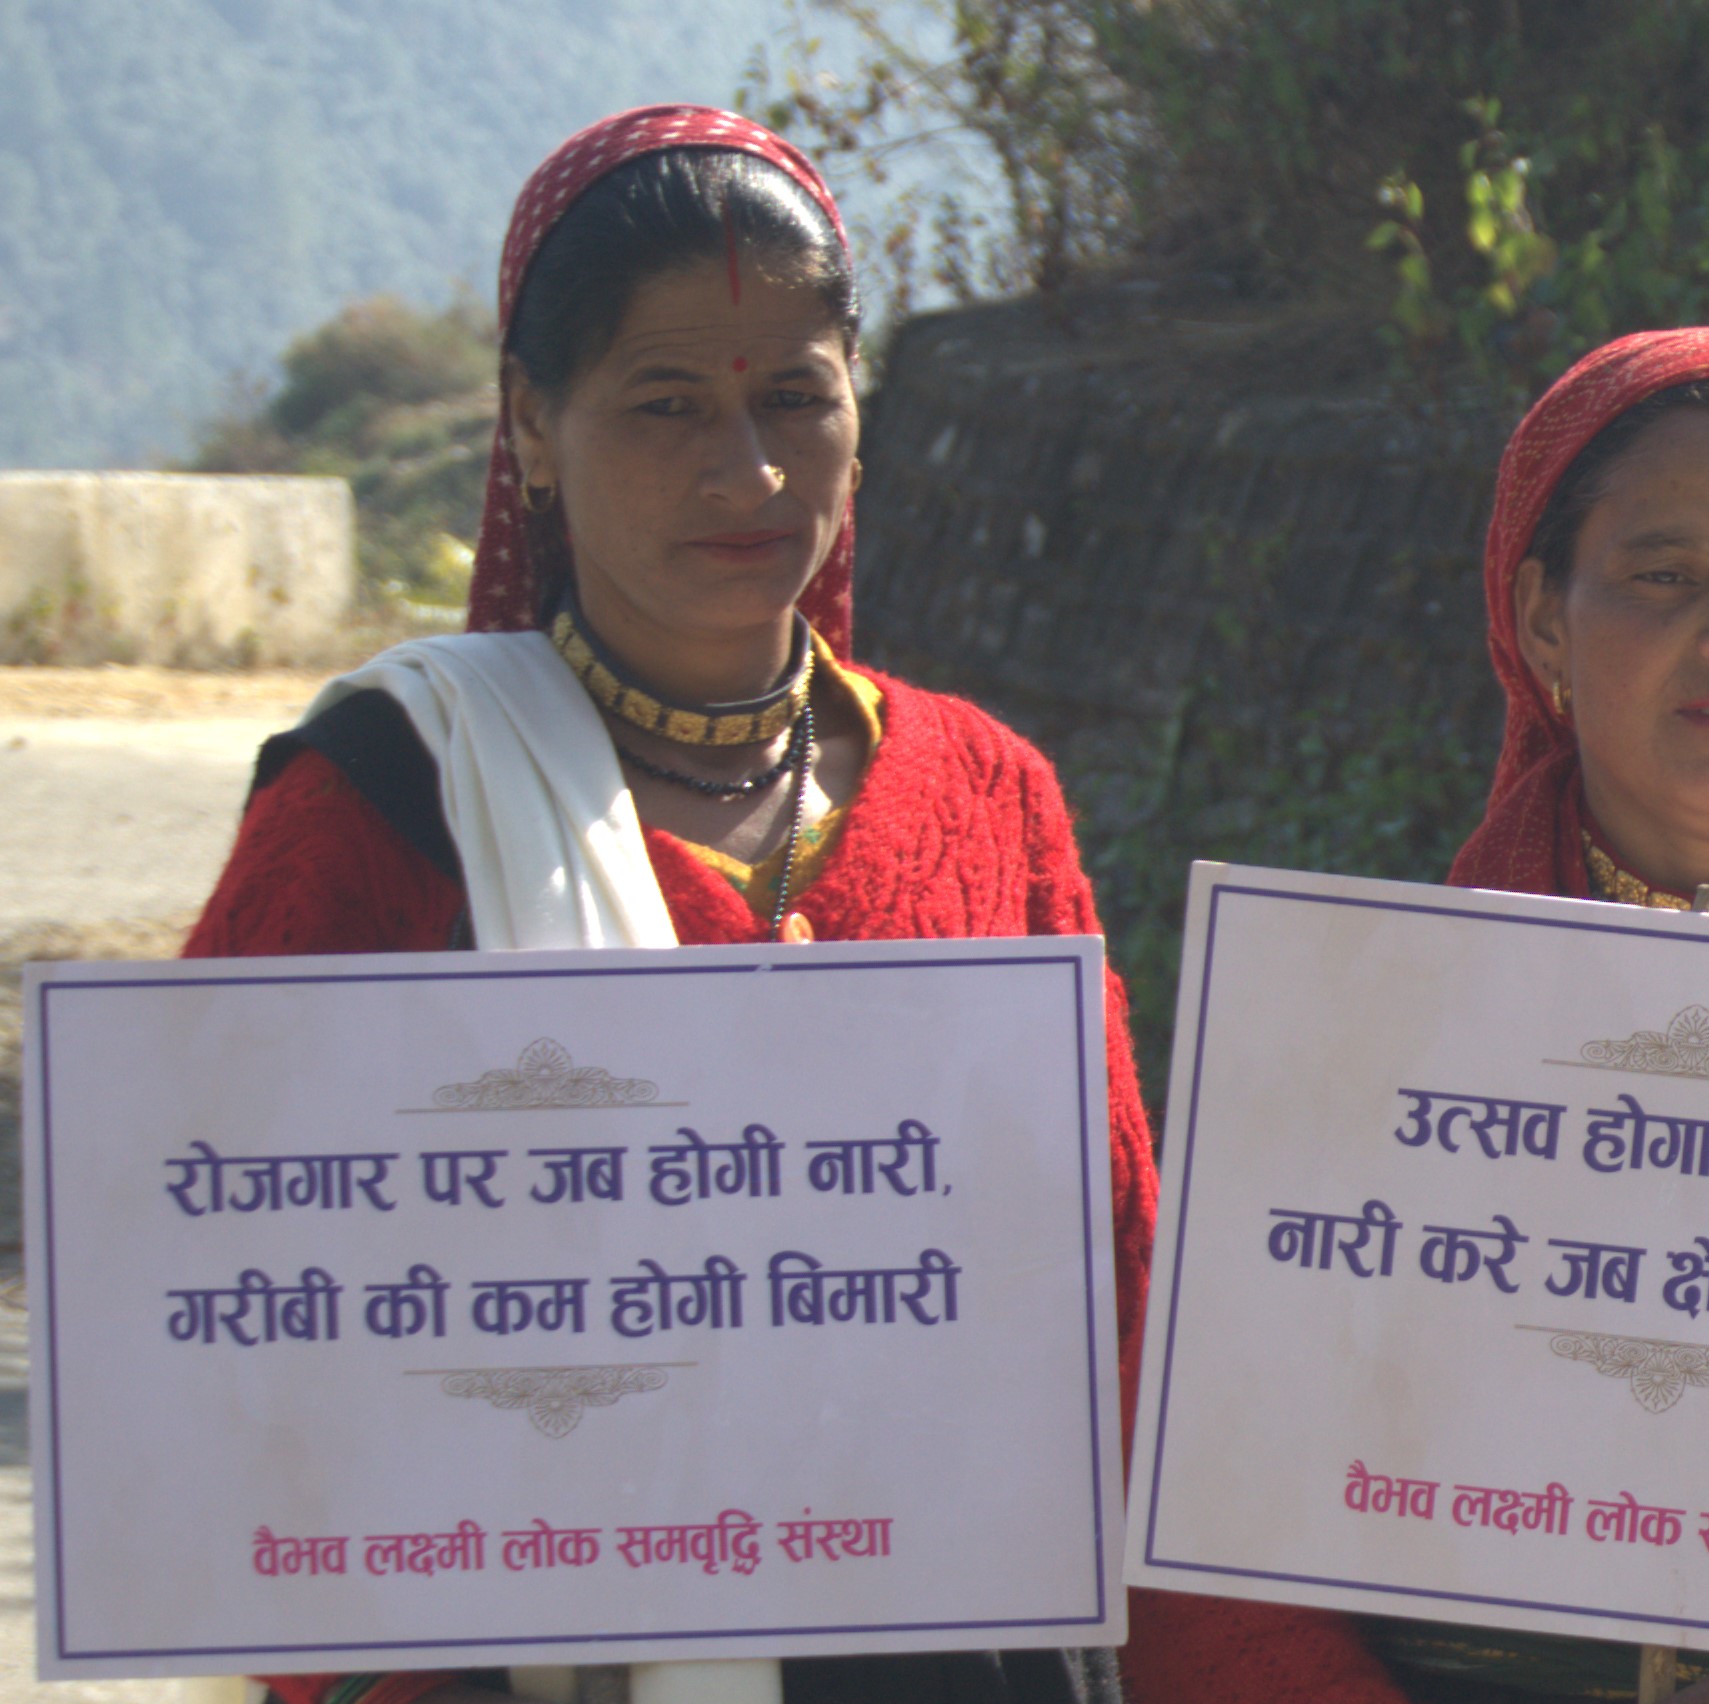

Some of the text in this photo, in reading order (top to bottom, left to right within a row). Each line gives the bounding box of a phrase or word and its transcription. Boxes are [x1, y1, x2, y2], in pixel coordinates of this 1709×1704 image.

[164, 1118, 952, 1218] रोजगार पर जब होगी नारी,
[1394, 1087, 1568, 1161] उत्सव
[166, 1248, 962, 1347] गरीबी की कम होगी बिमारी
[1267, 1199, 1404, 1279] नारी
[1419, 1214, 1530, 1294] करे
[1544, 1238, 1647, 1304] जब
[252, 1525, 350, 1577] वैभव
[363, 1519, 488, 1577] लक्ष्मी
[501, 1517, 603, 1572] लोक
[776, 1507, 894, 1563] संस्था
[1344, 1459, 1441, 1521] वैभव
[1451, 1481, 1575, 1536] लक्ष्मी
[1585, 1490, 1687, 1547] लोक
